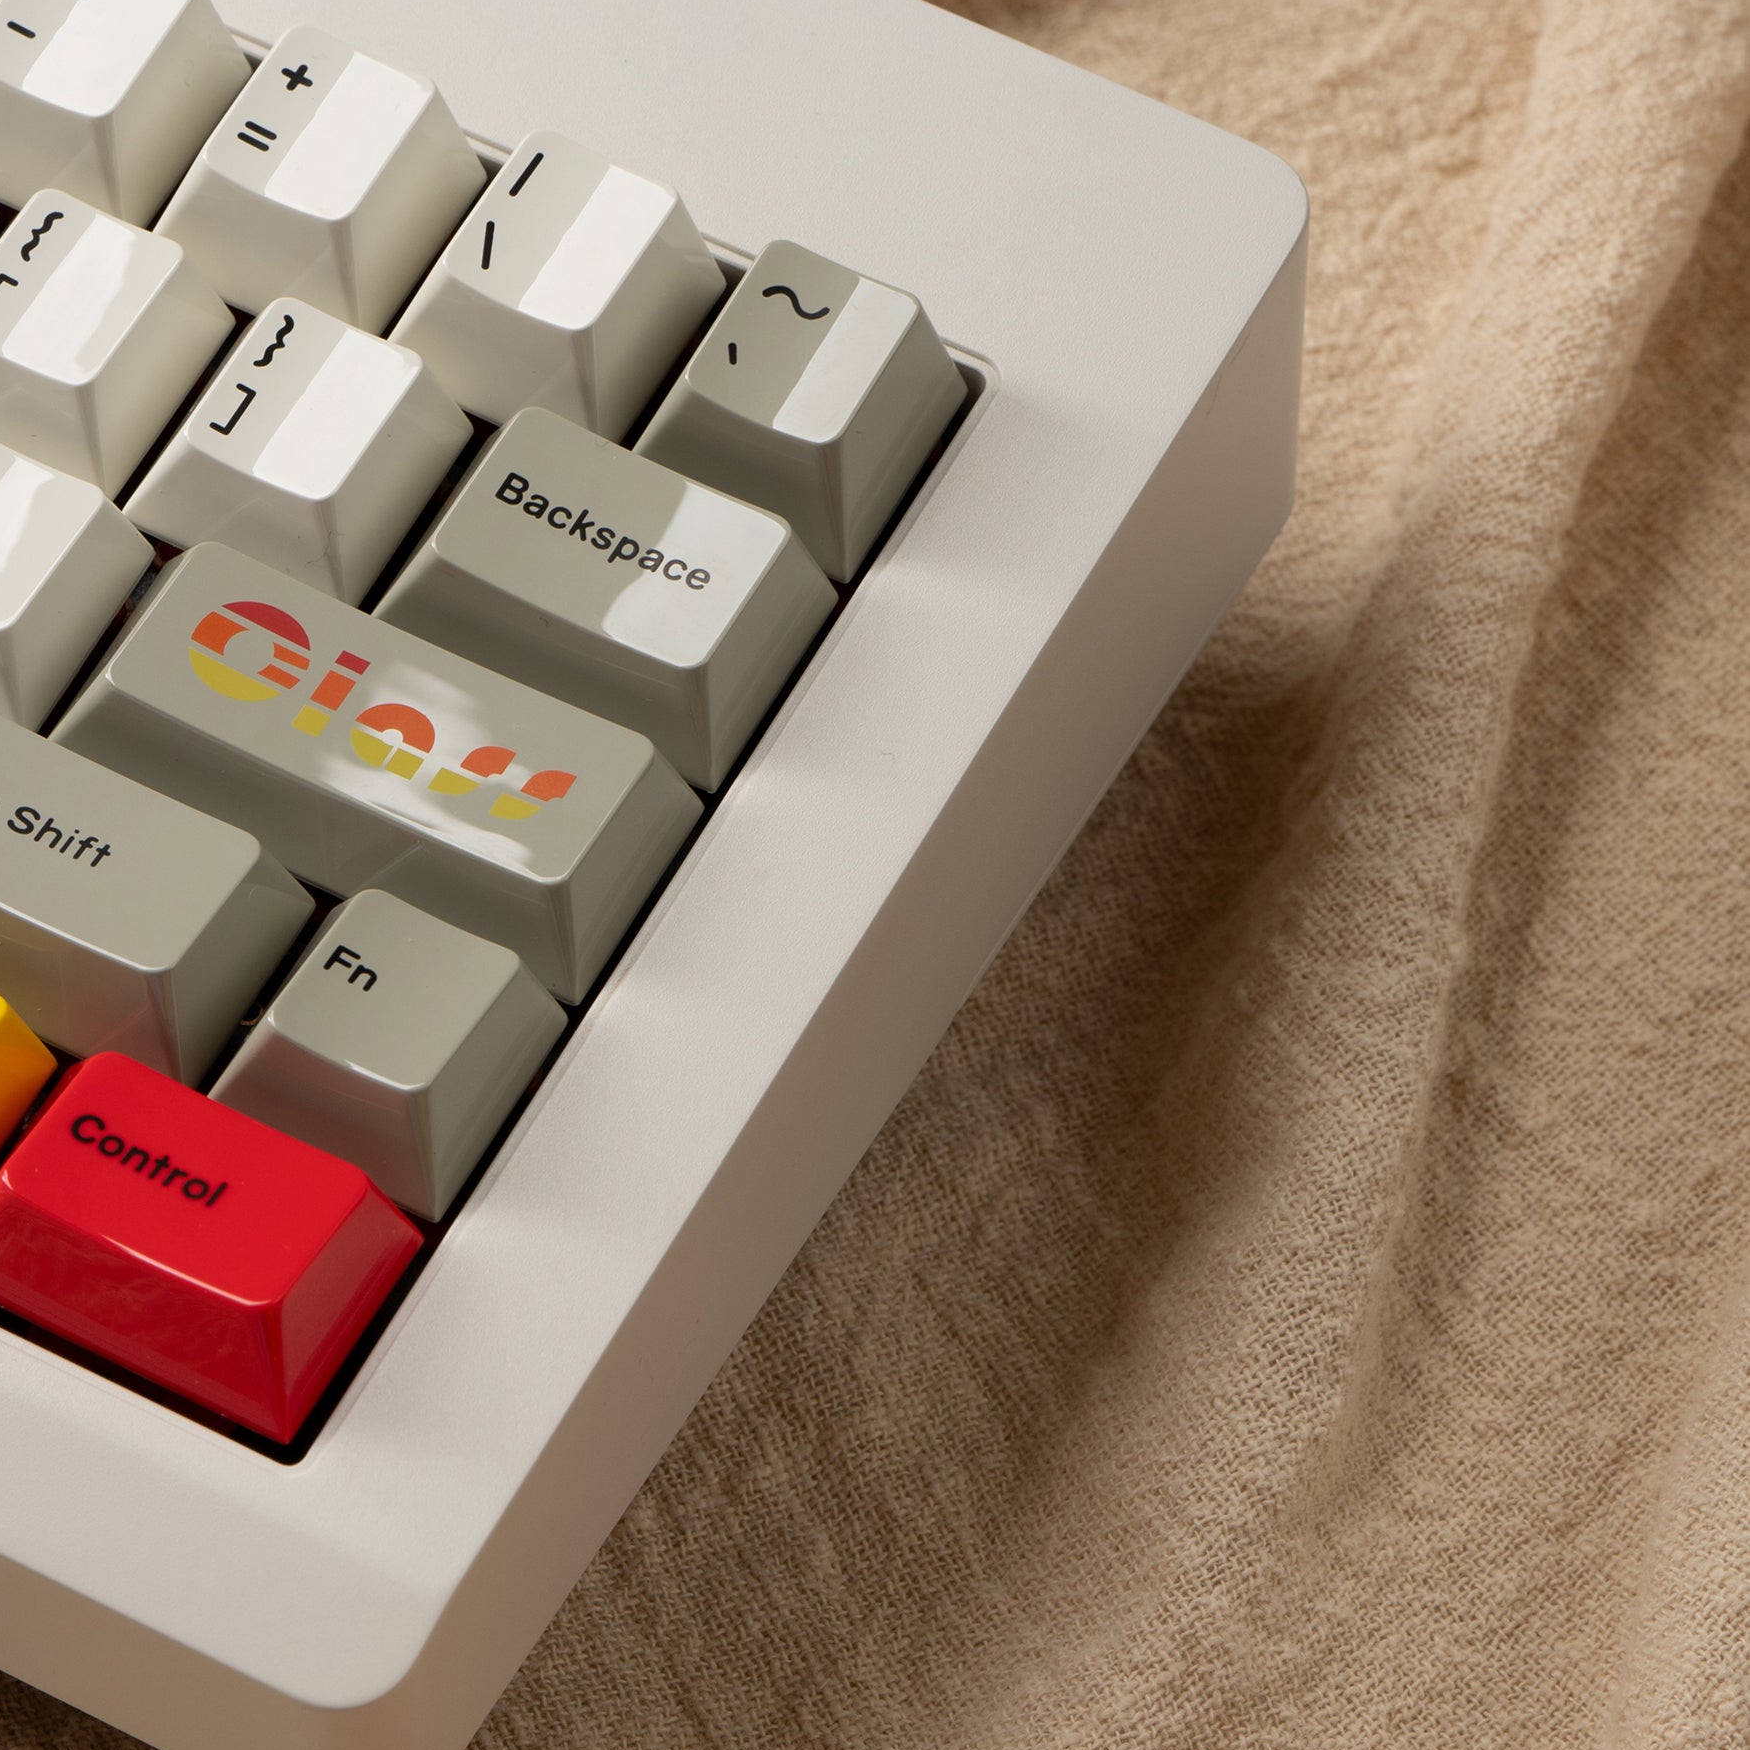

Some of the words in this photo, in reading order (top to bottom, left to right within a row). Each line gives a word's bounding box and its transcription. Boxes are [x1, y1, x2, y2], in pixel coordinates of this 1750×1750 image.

[493, 470, 711, 591] Backspace
[5, 805, 112, 869] Shift
[322, 943, 379, 993] Fn
[68, 1112, 230, 1209] Control
